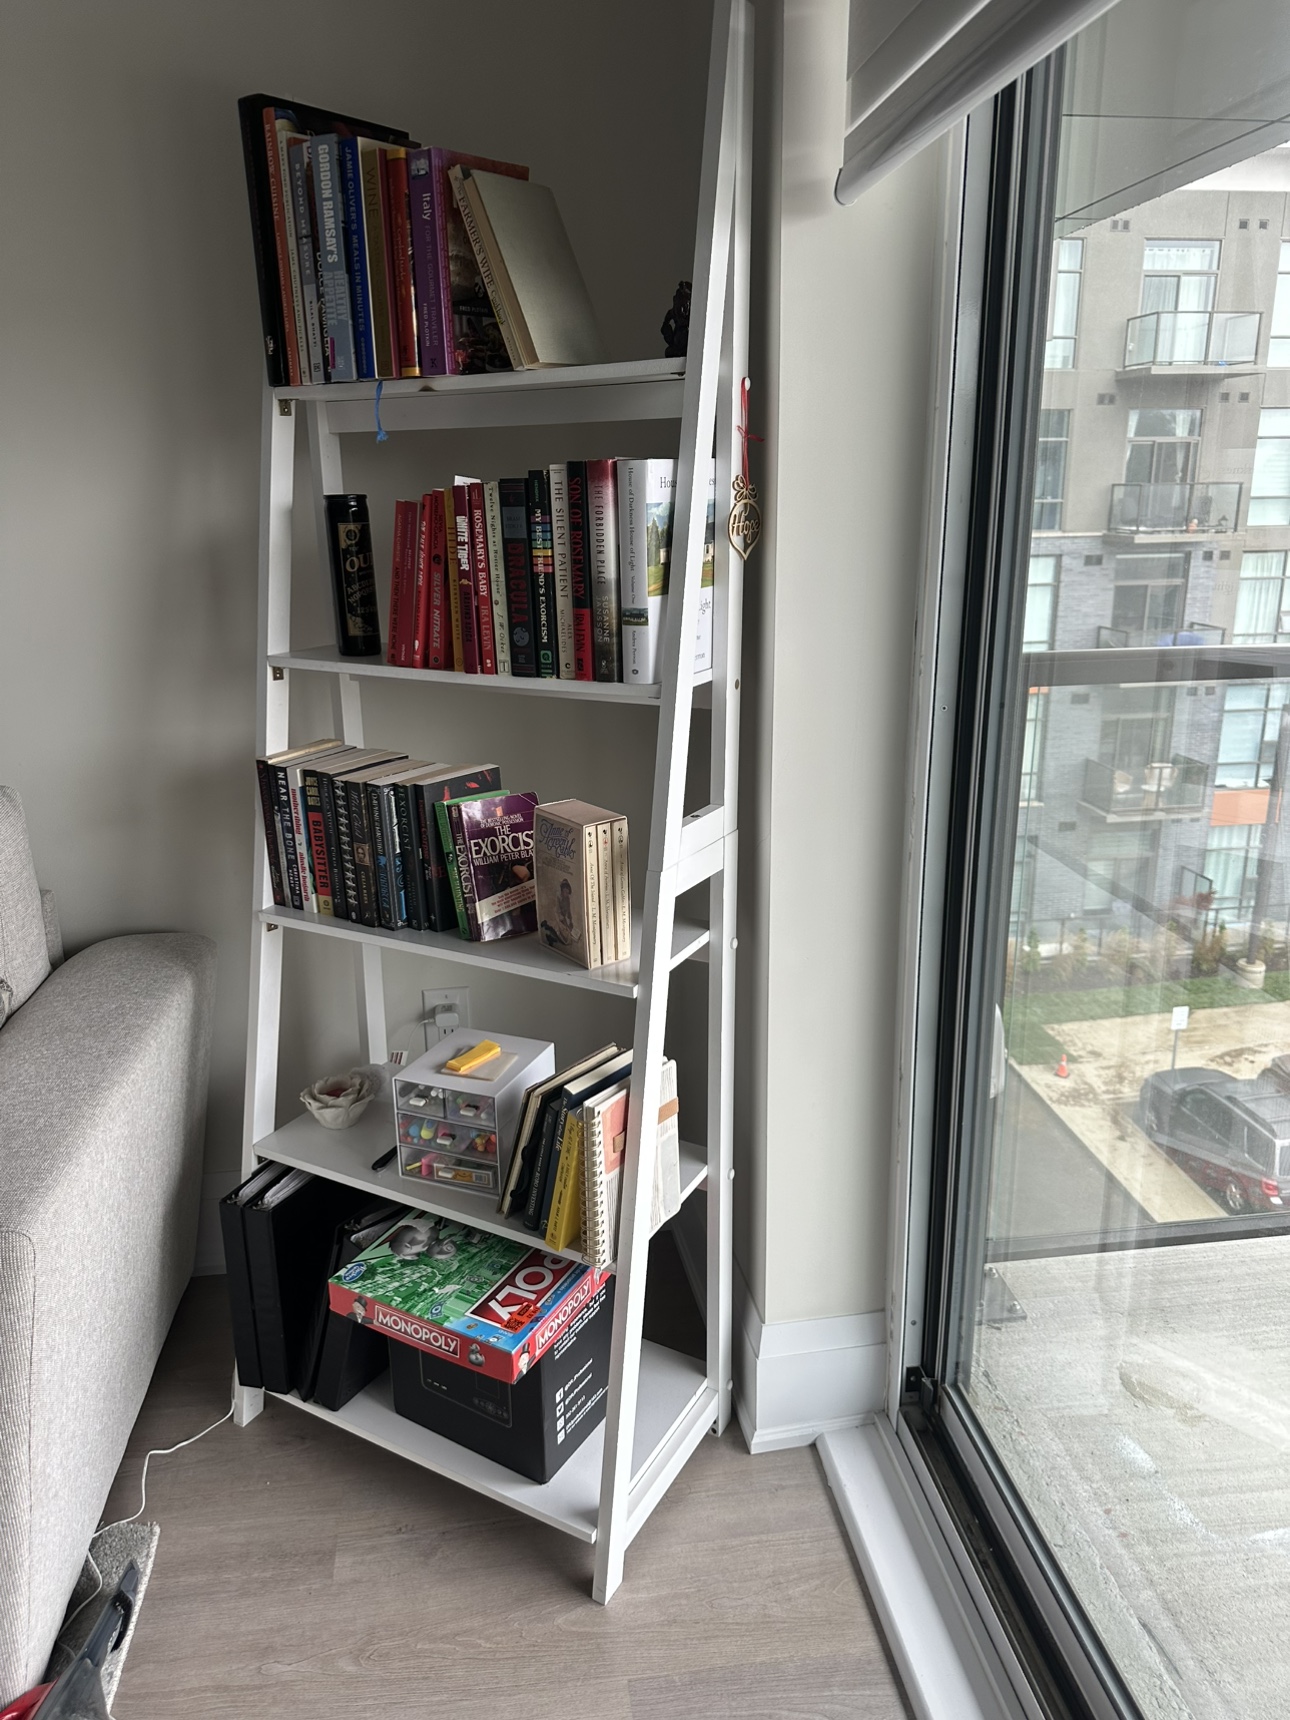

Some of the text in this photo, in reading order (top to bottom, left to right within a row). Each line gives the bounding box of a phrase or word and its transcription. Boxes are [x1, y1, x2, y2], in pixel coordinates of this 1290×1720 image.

[264, 123, 280, 221] RAINBOW CUISINE
[344, 146, 354, 179] JAMIE
[316, 143, 338, 263] GORDON RAMSAY'S
[347, 180, 358, 230] OLIVER'S
[365, 166, 379, 218] WINE
[420, 192, 433, 221] Italy
[294, 162, 311, 276] BEYOND MEASURE
[423, 224, 431, 242] FOR
[351, 233, 361, 270] MEALS
[457, 195, 507, 326] FARMER'S WIFE Cookbook
[333, 269, 348, 321] HEALTHY
[354, 271, 362, 283] IN
[426, 262, 435, 303] GOURMET
[323, 270, 338, 326] APPETITE
[355, 284, 365, 331] MINUTES
[458, 304, 471, 312] FRED
[429, 305, 438, 346] TRAVELER
[487, 487, 495, 512] Twelve
[534, 508, 542, 523] MY
[488, 514, 497, 538] Nights
[535, 525, 543, 549] BEST
[553, 480, 568, 599] THE SILENT PATIENT
[567, 476, 585, 600] SON OF ROSEMARY
[593, 484, 606, 585] THE FORBIDDEN PLACE
[731, 509, 760, 543] Hope
[447, 525, 458, 565] HIDE
[627, 554, 636, 571] Light
[454, 514, 473, 642] WHITE TIGER ARAVIND ADIGA
[472, 508, 491, 650] ROSEMARY'S BABY IRA LEVIN
[506, 541, 529, 624] DRACULA
[536, 551, 545, 594] FRIEND'S
[390, 616, 398, 633] WERE
[432, 571, 441, 648] SILVER NITRATE
[538, 595, 548, 643] EXORCISM
[595, 596, 603, 643] JANSSON
[601, 594, 609, 642] SUSANNE
[389, 634, 397, 650] NONE
[498, 631, 506, 653] Ocker
[558, 608, 567, 653] MICHAELIDES
[573, 612, 586, 652] IRA LEVIN
[276, 770, 288, 801] NEAR
[281, 806, 291, 827] THE
[289, 787, 303, 835] motherthing
[321, 777, 334, 834] HOUR WITCH
[349, 789, 364, 839] Witch Child
[371, 792, 380, 822] DAPHNE
[396, 792, 412, 851] EXORCIST
[485, 820, 502, 828] DEMONIC
[502, 817, 524, 825] POSSESSION
[487, 814, 510, 823] BESTSELLING
[284, 831, 295, 860] BONE
[420, 827, 431, 859] Corpse
[470, 830, 534, 859] EXORCIS
[494, 824, 512, 836] THE
[539, 818, 564, 843] Anne
[556, 837, 576, 860] Gables
[311, 818, 329, 889] BABYSITTER
[330, 846, 338, 866] CHRIS
[454, 831, 474, 899] THE EXORCIST
[473, 851, 520, 867] WILLIAM PETER
[291, 863, 300, 894] CHRISTINA
[378, 872, 390, 909] REBECCA
[450, 879, 465, 912] HAUNTING
[557, 1106, 568, 1125] Story
[554, 1135, 564, 1152] Life
[532, 1170, 541, 1188] ROBO
[526, 1186, 538, 1216] INVESTING
[377, 1309, 458, 1353] MONOPOLY
[538, 1283, 590, 1349] MONOPOLY
